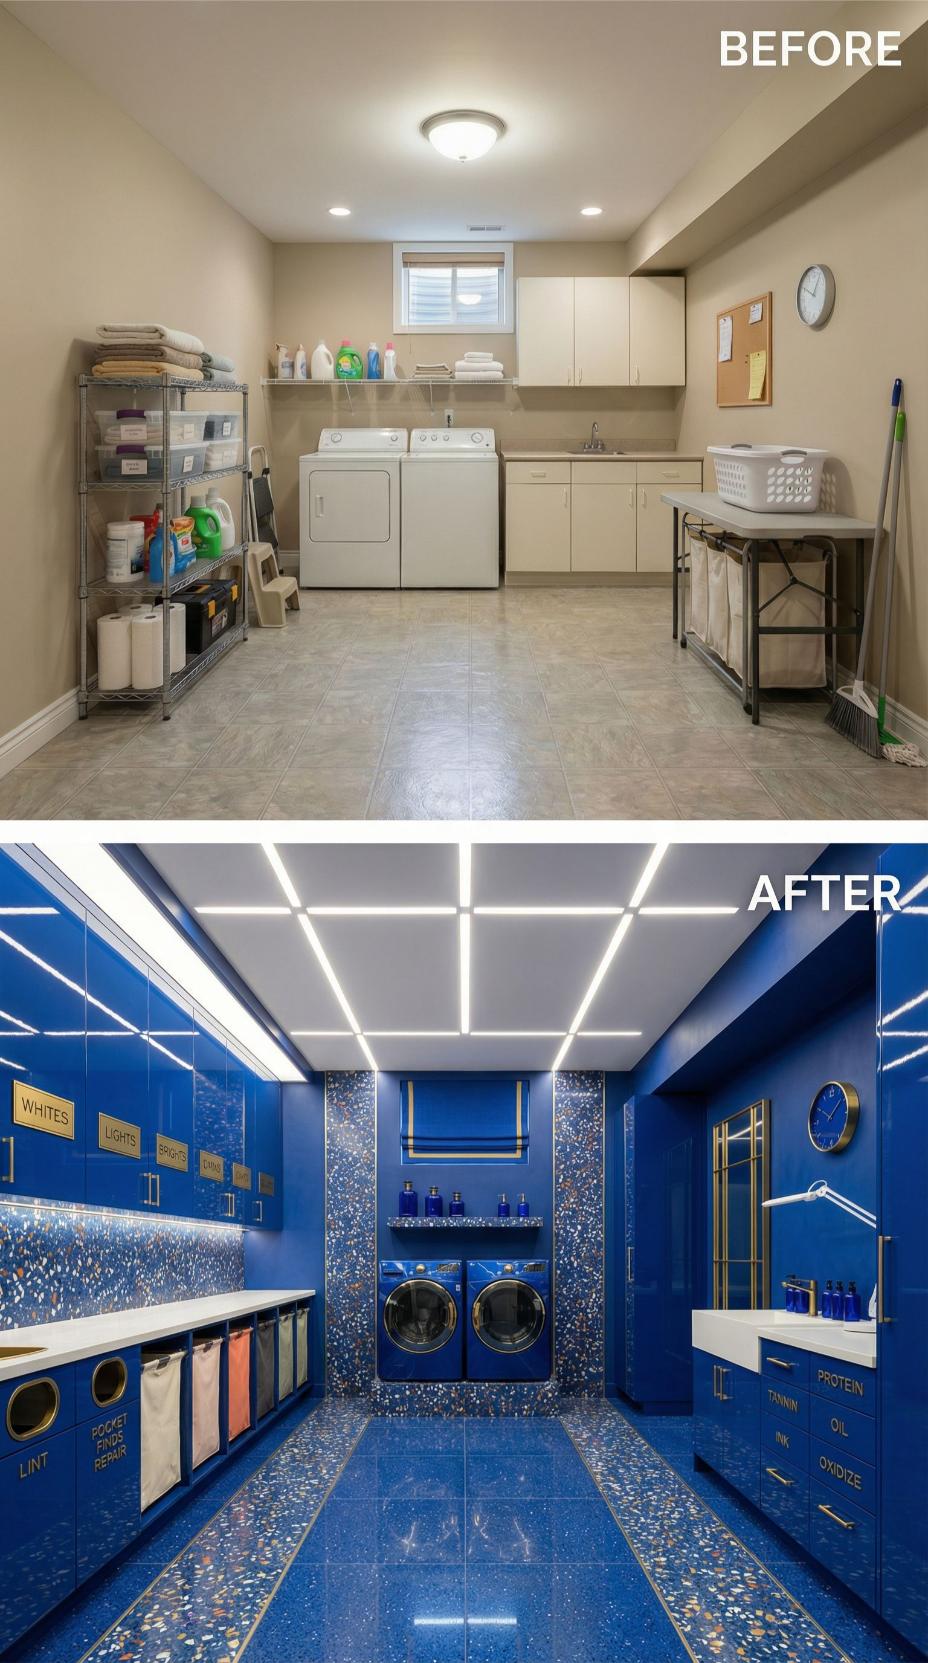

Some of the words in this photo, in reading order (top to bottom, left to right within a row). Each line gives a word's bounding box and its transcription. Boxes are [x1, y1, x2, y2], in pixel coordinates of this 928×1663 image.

[21, 1097, 69, 1125] WHITES
[105, 1125, 136, 1147] LIGHTS
[817, 1369, 864, 1397] PROTEIN
[767, 1389, 799, 1412] TANNIN
[91, 1412, 128, 1440] POCKET
[775, 1431, 790, 1448] INK
[830, 1417, 849, 1437] OIL
[96, 1430, 124, 1454] FINDS
[19, 1451, 49, 1479] LINT
[94, 1444, 127, 1473] REPAIR
[819, 1456, 862, 1490] OXIDIZE
